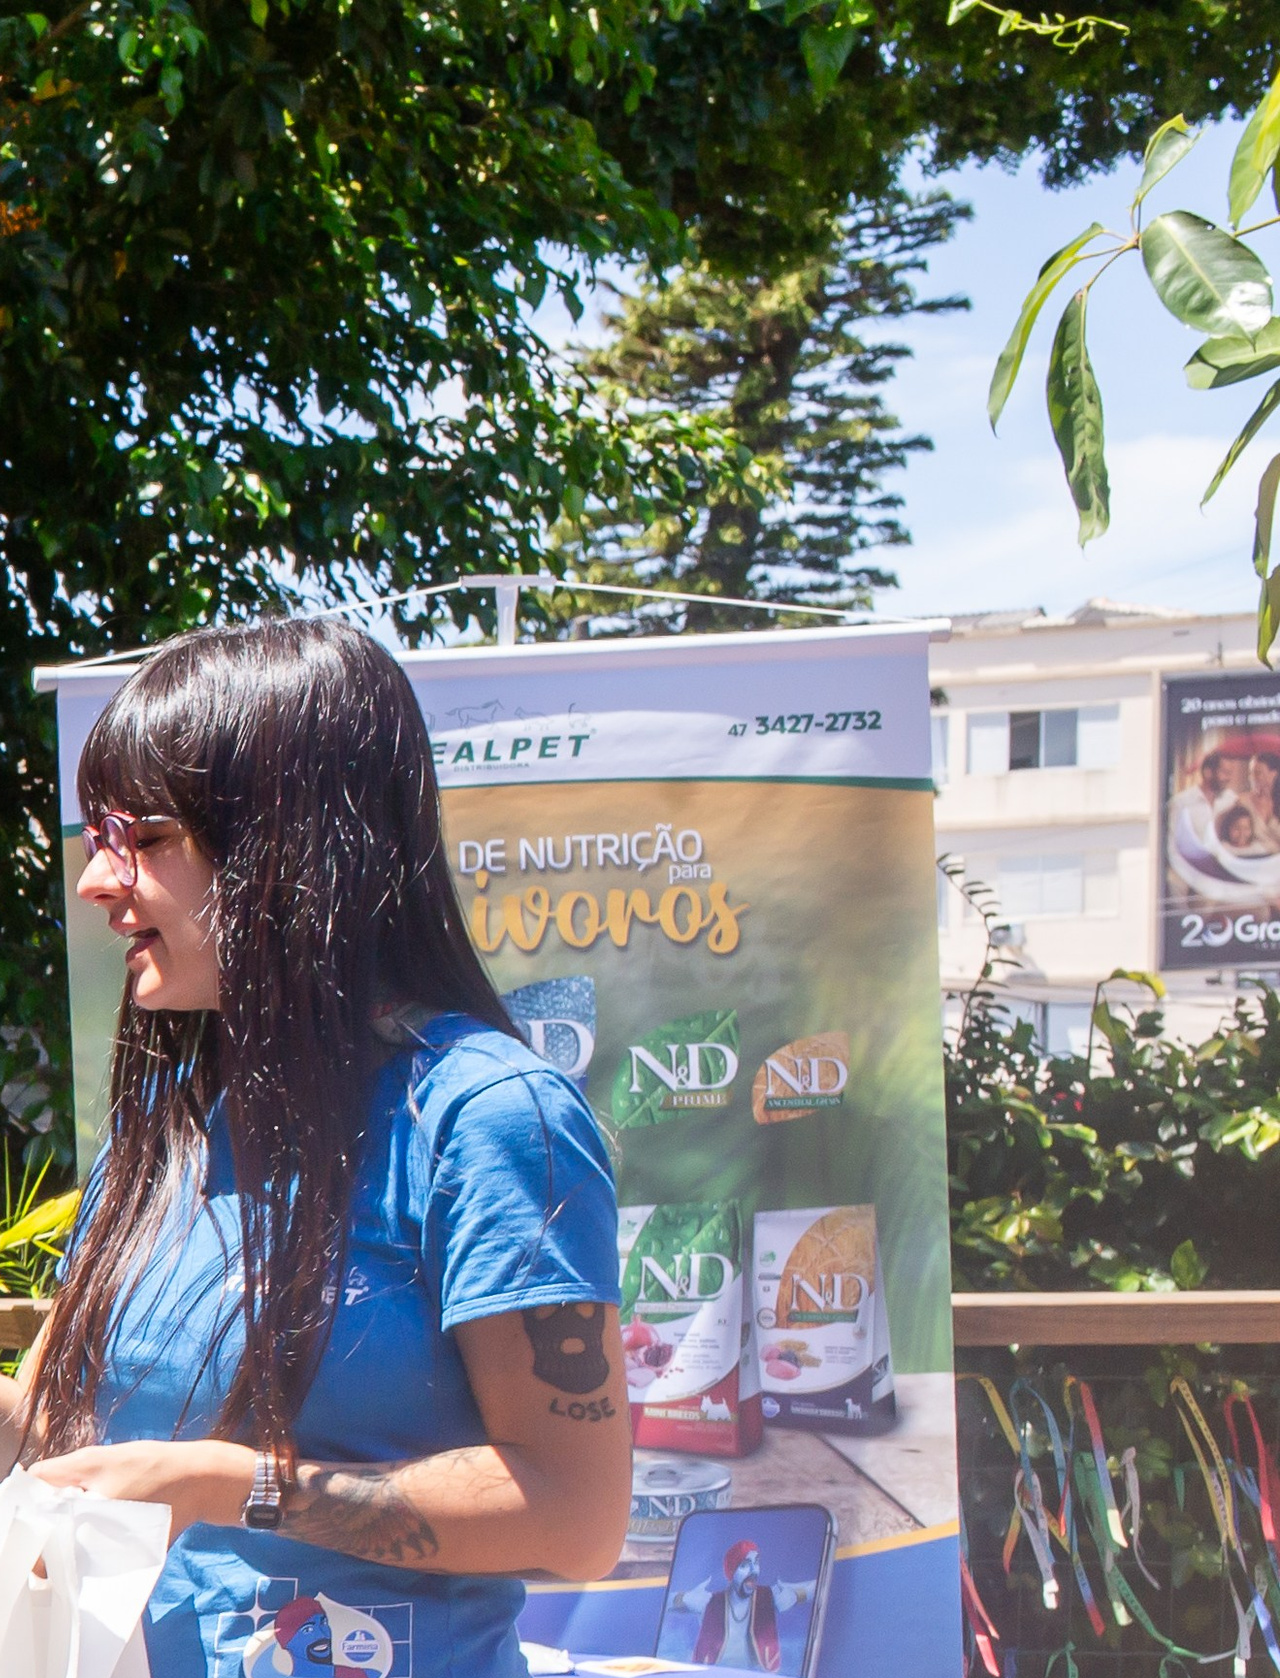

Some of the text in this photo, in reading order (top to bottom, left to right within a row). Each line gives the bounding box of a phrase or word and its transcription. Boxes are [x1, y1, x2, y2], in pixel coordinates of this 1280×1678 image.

[727, 710, 882, 737] 47 3427-2732
[453, 762, 531, 773] DISTRIBUIDORA
[458, 822, 704, 873] DE NUTRIÇÃO
[669, 862, 712, 884] para
[628, 1043, 739, 1092] N&D
[765, 1056, 848, 1096] N&D
[672, 1093, 727, 1106] PRIME
[637, 1252, 734, 1301] N&D
[790, 1272, 870, 1311] N&D
[549, 1396, 616, 1422] LOSE
[342, 1641, 378, 1651] Farmina
